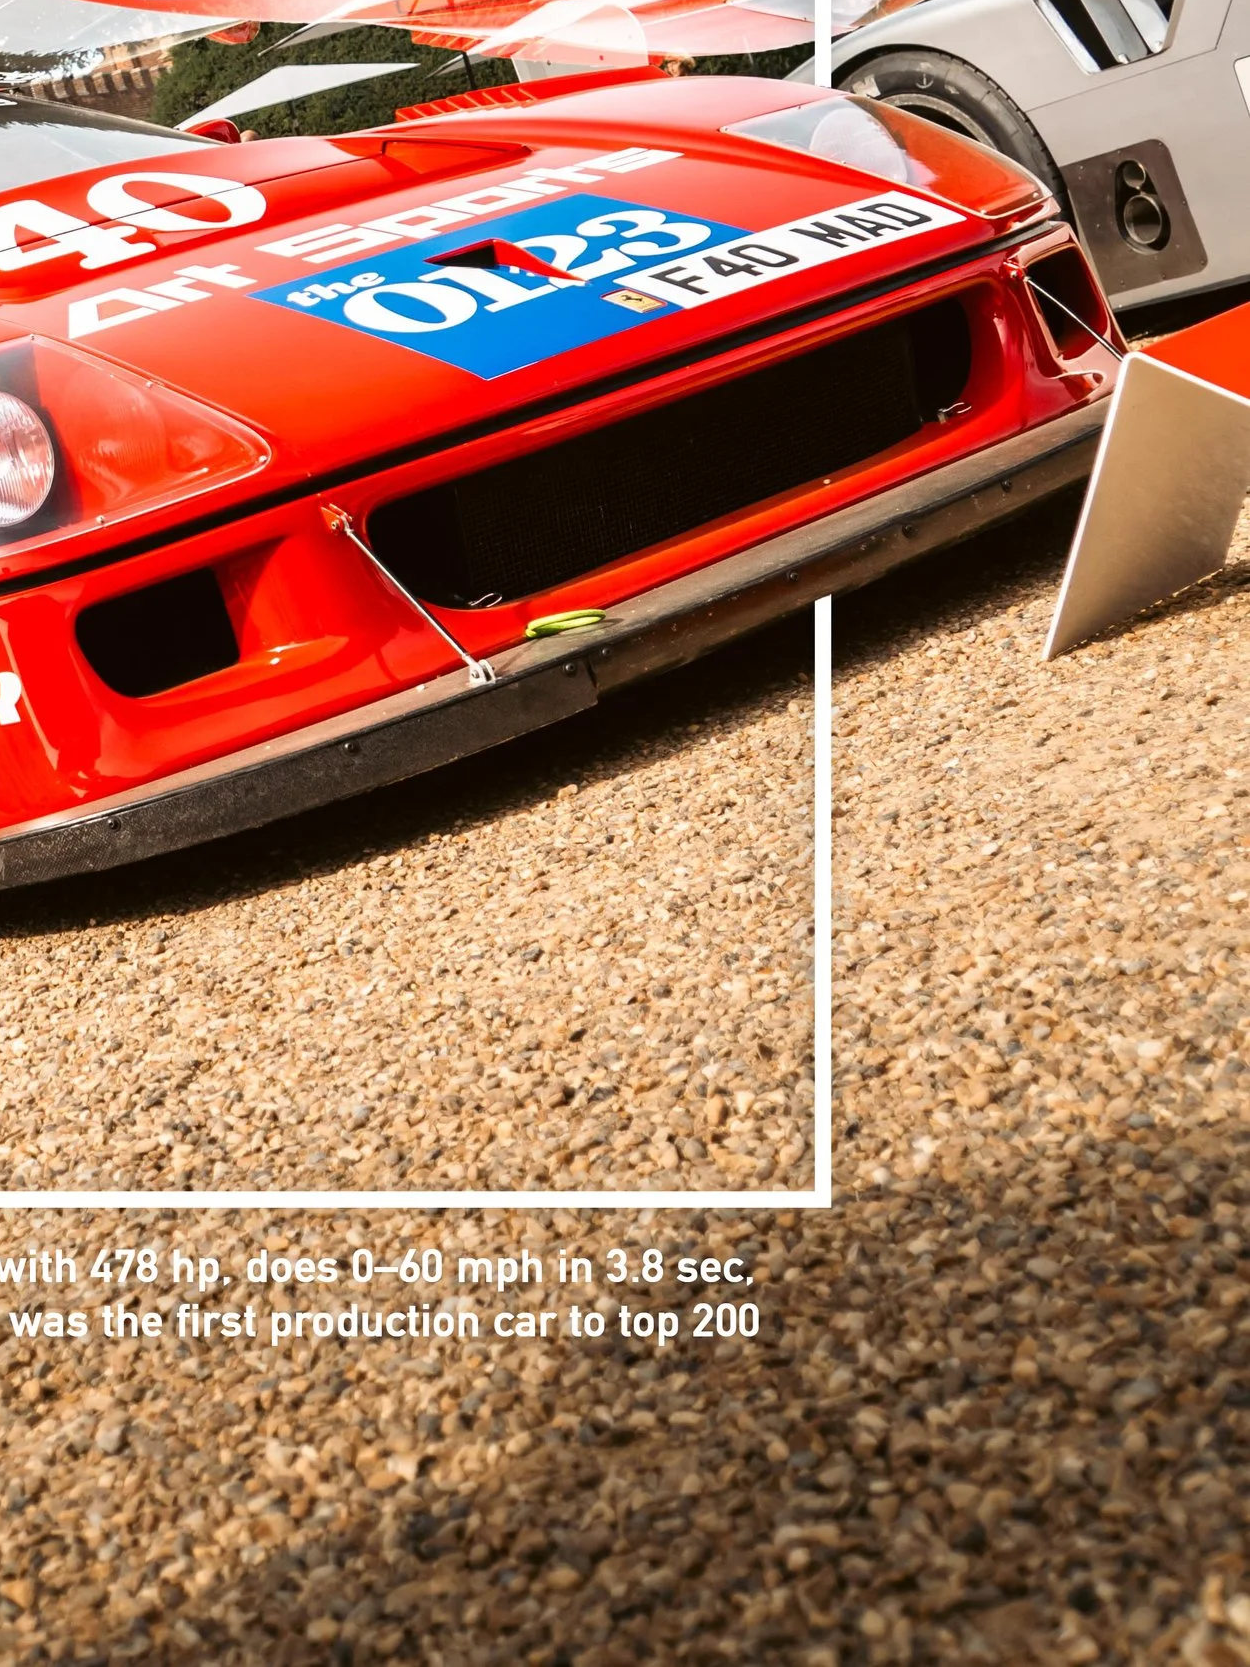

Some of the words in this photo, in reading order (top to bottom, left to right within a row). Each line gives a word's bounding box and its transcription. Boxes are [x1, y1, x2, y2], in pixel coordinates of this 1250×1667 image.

[68, 263, 270, 339] Art
[255, 147, 685, 264] Sports
[286, 270, 386, 308] the
[344, 209, 713, 333] 0123
[647, 243, 801, 296] F40
[797, 201, 934, 252] MAD
